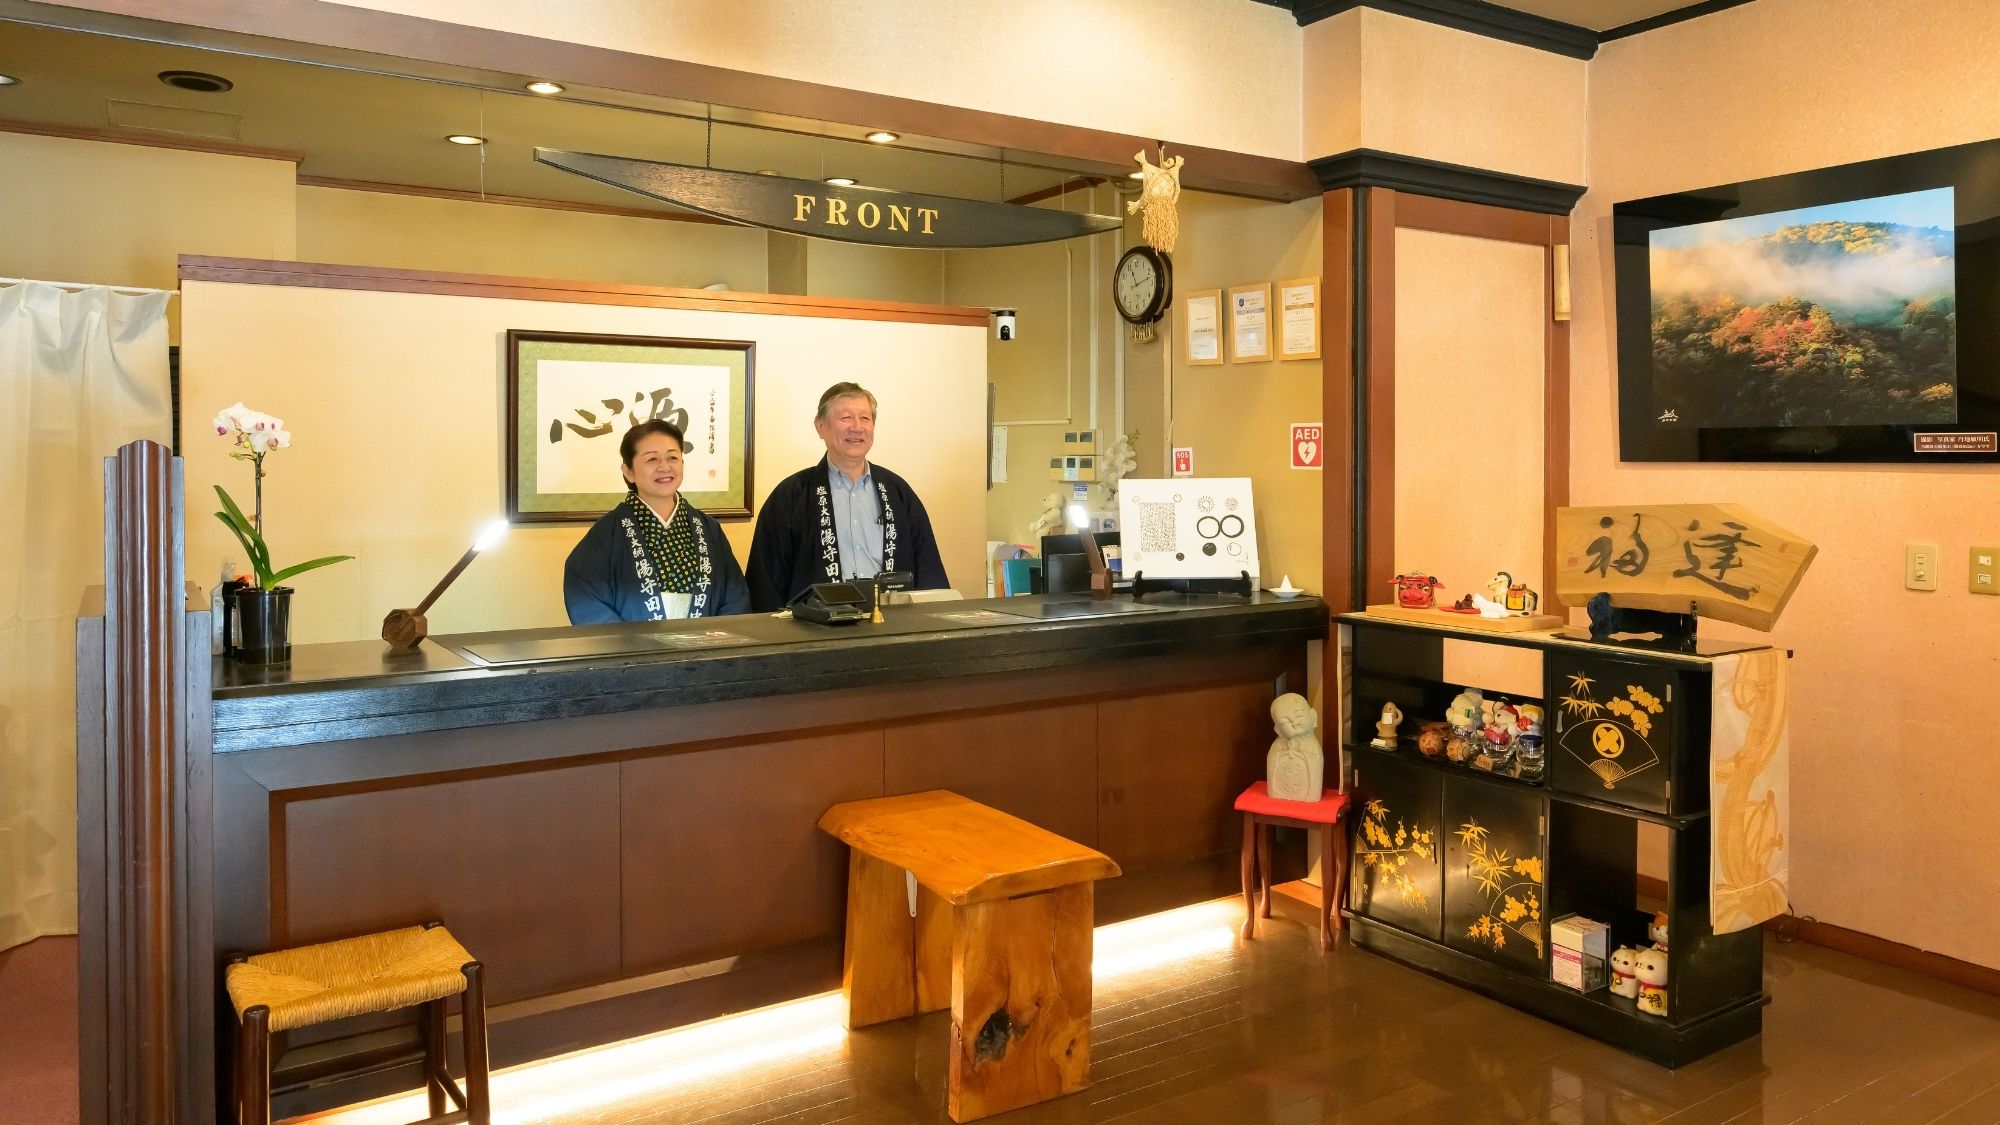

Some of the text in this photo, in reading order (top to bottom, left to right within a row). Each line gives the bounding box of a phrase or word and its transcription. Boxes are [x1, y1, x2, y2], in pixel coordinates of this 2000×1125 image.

[793, 194, 939, 235] FRONT
[1295, 428, 1320, 440] AED
[1176, 451, 1189, 459] SOS
